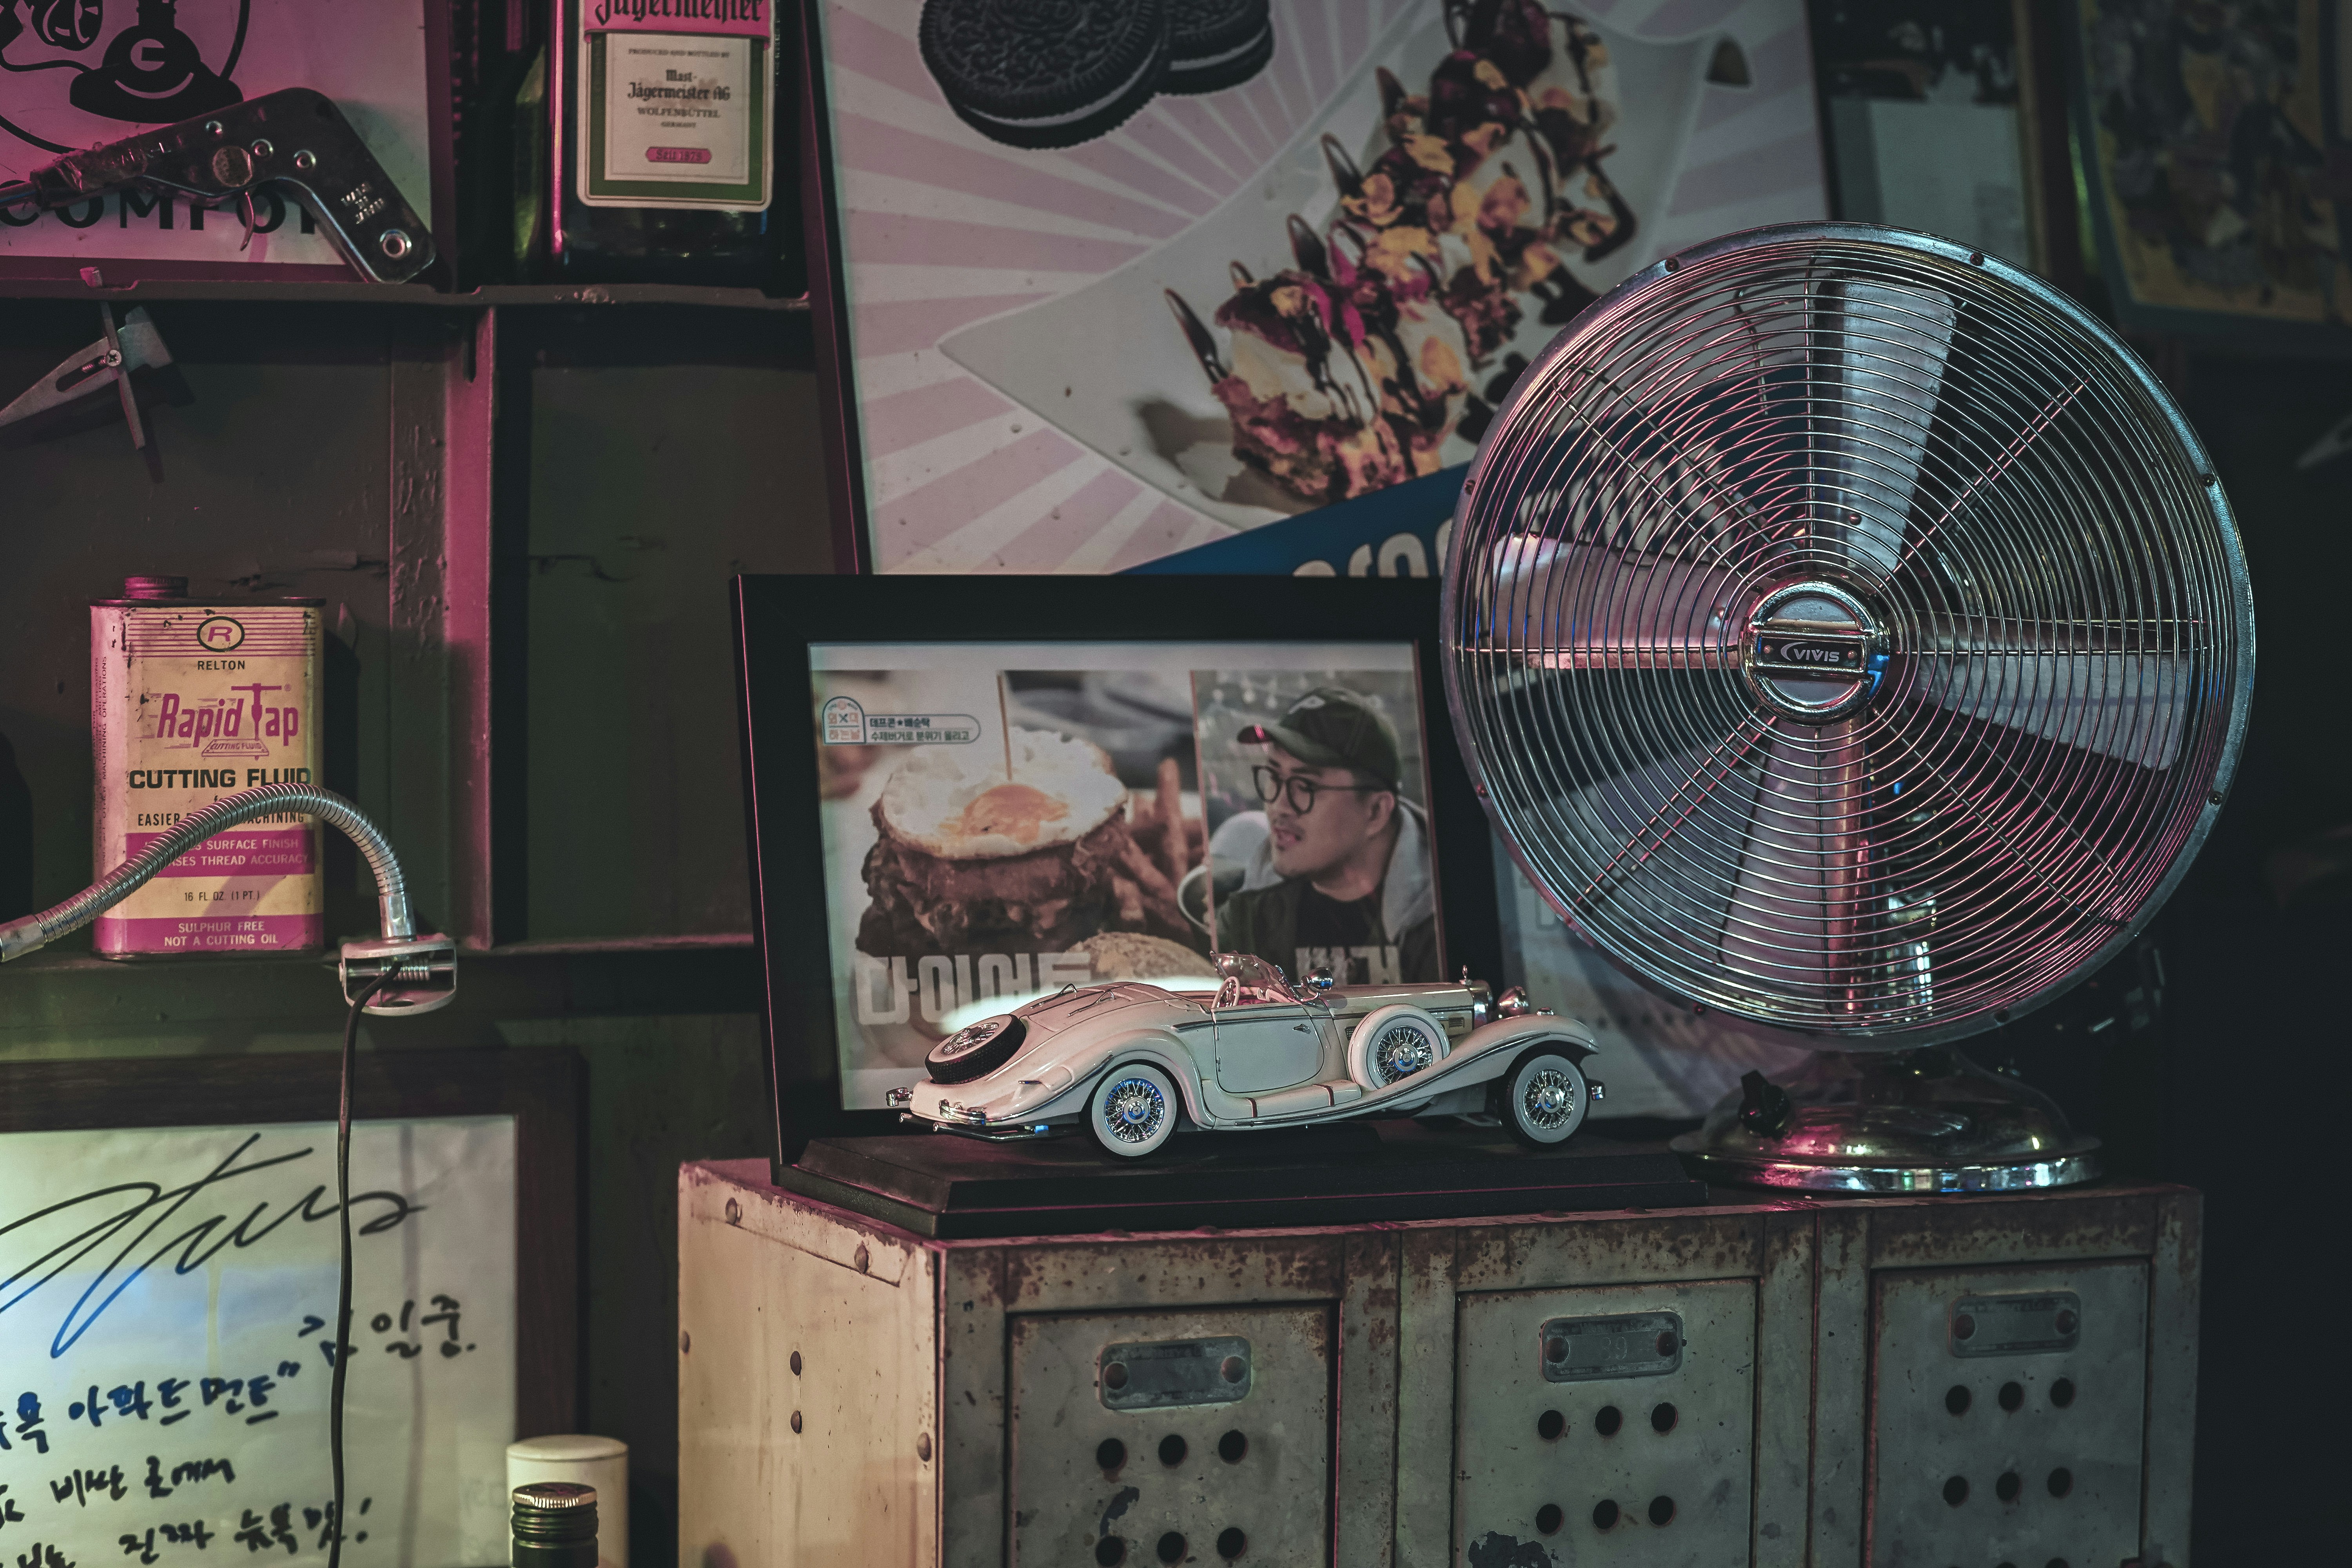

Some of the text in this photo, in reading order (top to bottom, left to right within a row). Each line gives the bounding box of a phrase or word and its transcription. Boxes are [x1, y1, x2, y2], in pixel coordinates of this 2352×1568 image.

[627, 81, 710, 102] Jägermeister
[207, 626, 233, 642] R
[1793, 648, 1840, 662] VIVIS
[197, 660, 245, 670] RELTON
[157, 693, 245, 748] Rapid
[230, 683, 299, 746] Tap
[129, 767, 312, 789] CUTTING FLUID
[138, 813, 180, 826] EASIER
[207, 839, 257, 850] SURFACE
[263, 838, 299, 849] FINISH
[201, 855, 246, 866] THREAD
[250, 853, 308, 864] ACCURACY
[184, 892, 194, 902] 16
[199, 892, 208, 902] FL
[178, 920, 265, 933] SULPHUR FREE
[164, 933, 279, 947] NOT A CUTTING OIL
[857, 953, 1091, 1024] 다이어트
[0, 1391, 49, 1454] 욕
